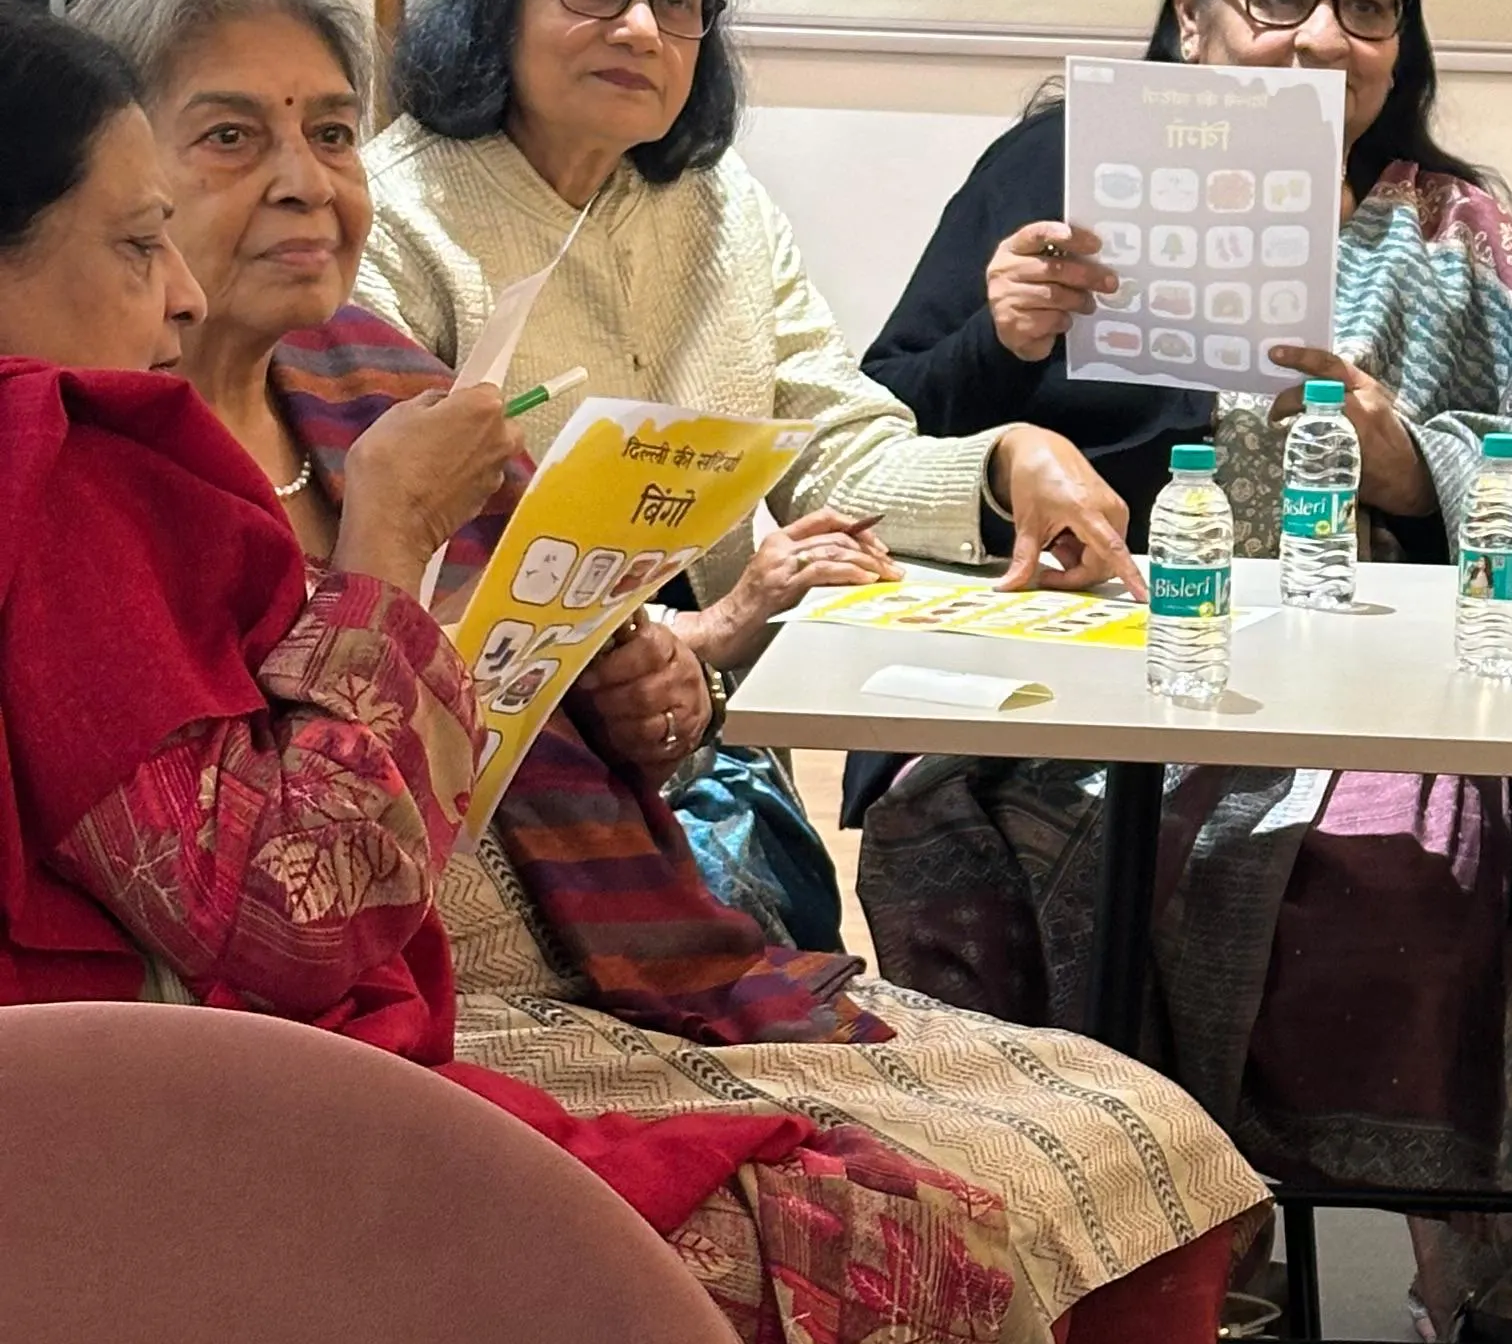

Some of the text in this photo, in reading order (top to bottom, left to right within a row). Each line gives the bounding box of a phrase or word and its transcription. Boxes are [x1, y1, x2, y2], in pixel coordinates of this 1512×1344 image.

[621, 435, 671, 466] दिल्ली
[672, 444, 695, 471] की
[629, 482, 697, 529] बिंगो
[1283, 495, 1328, 516] Bisleri
[1154, 575, 1212, 598] Bisleri
